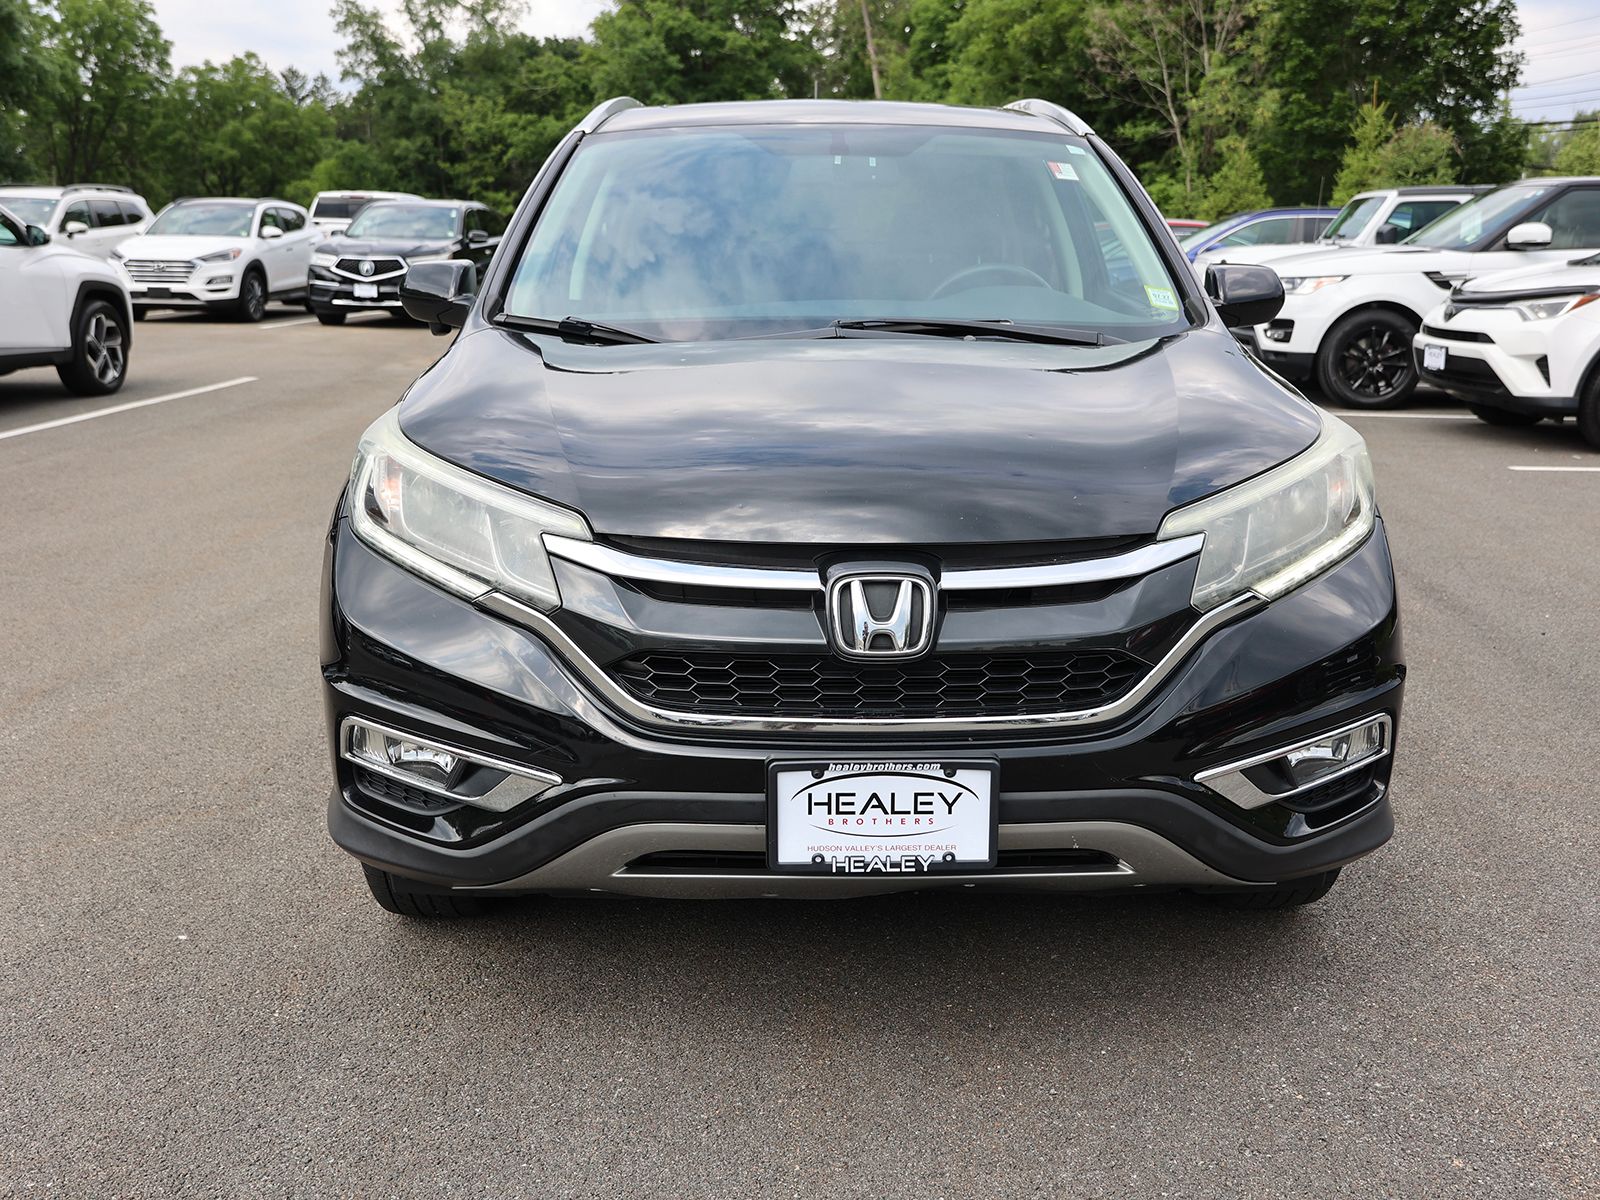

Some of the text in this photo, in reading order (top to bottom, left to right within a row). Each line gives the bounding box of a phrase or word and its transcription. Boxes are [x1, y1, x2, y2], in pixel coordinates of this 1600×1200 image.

[828, 763, 941, 772] healeybrothers.com
[807, 792, 963, 815] HEALEY
[831, 855, 935, 873] HEALEY
